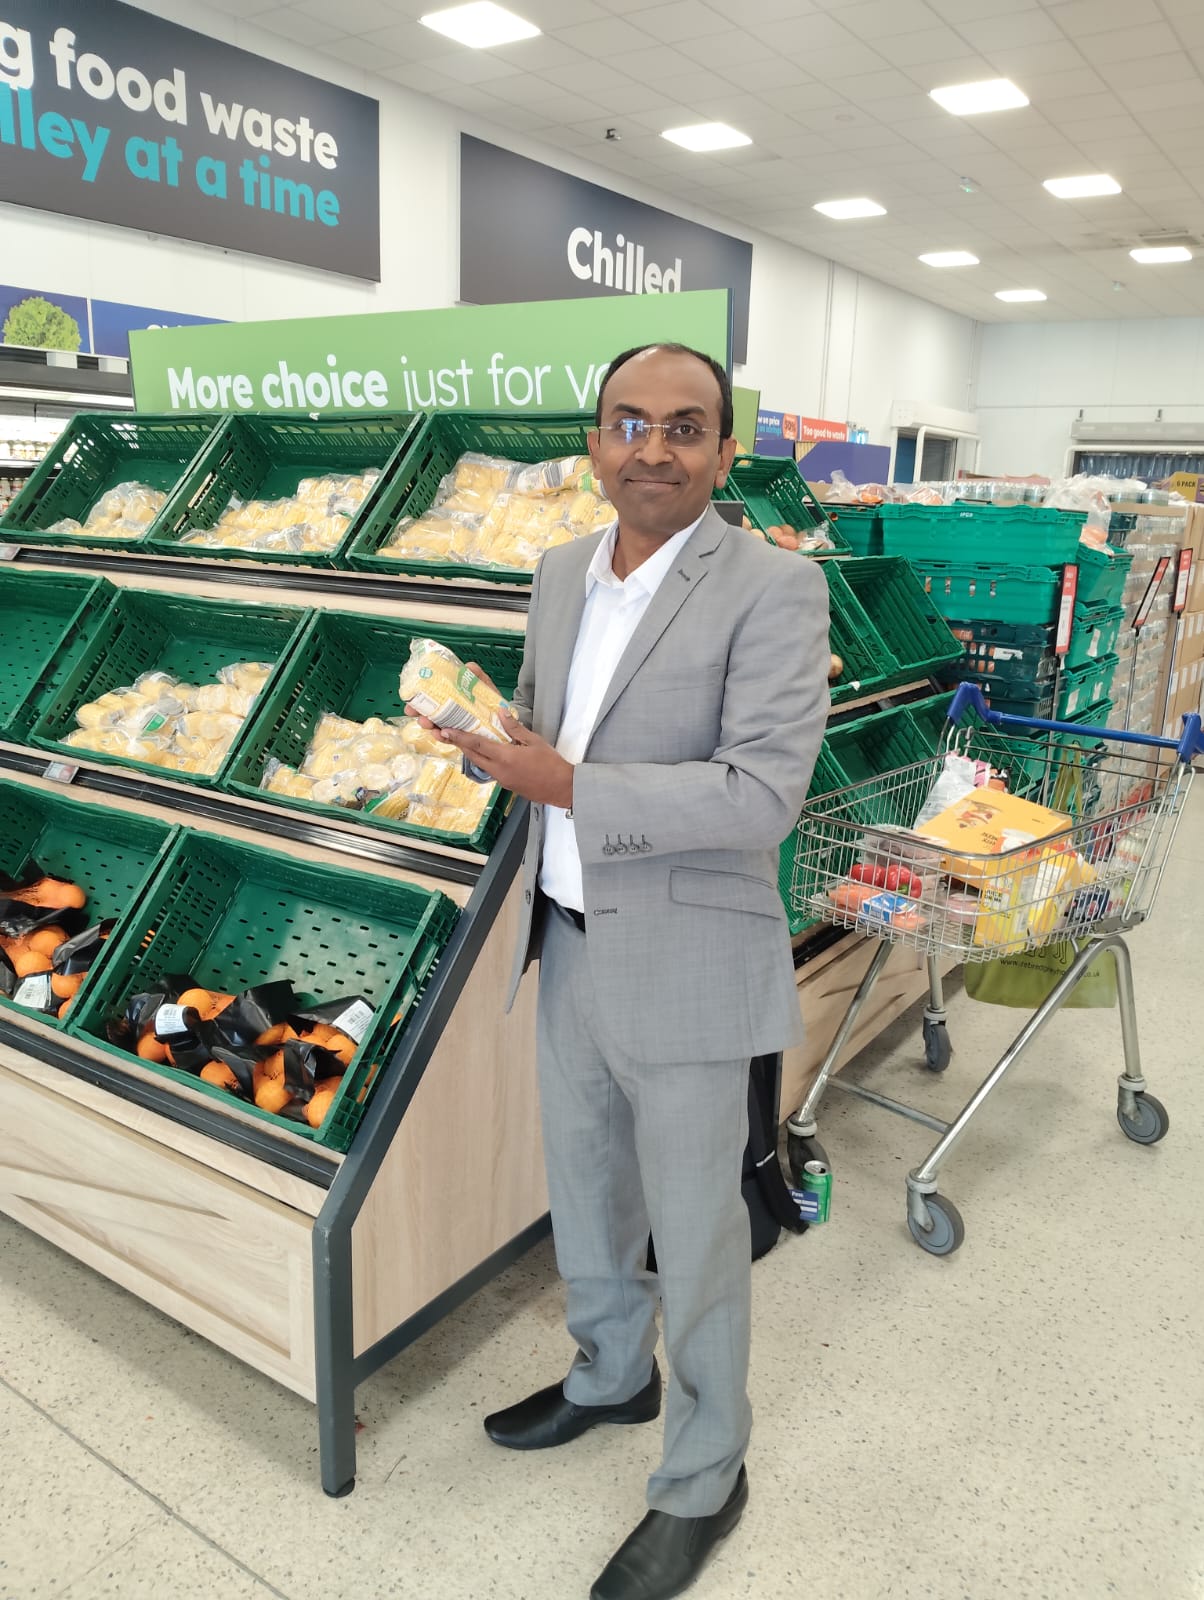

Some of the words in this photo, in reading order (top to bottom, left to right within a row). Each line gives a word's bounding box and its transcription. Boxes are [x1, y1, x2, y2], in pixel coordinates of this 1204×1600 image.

[49, 27, 188, 127] food
[200, 91, 339, 170] waste
[0, 81, 111, 182] lley
[125, 135, 183, 188] at
[196, 155, 227, 200] a
[240, 154, 340, 227] time
[567, 226, 682, 295] Chilled
[167, 366, 254, 409] More
[261, 353, 389, 408] choice
[401, 355, 473, 411] just
[487, 352, 552, 406] for
[803, 425, 813, 435] Too
[813, 427, 826, 439] good
[827, 429, 832, 438] to
